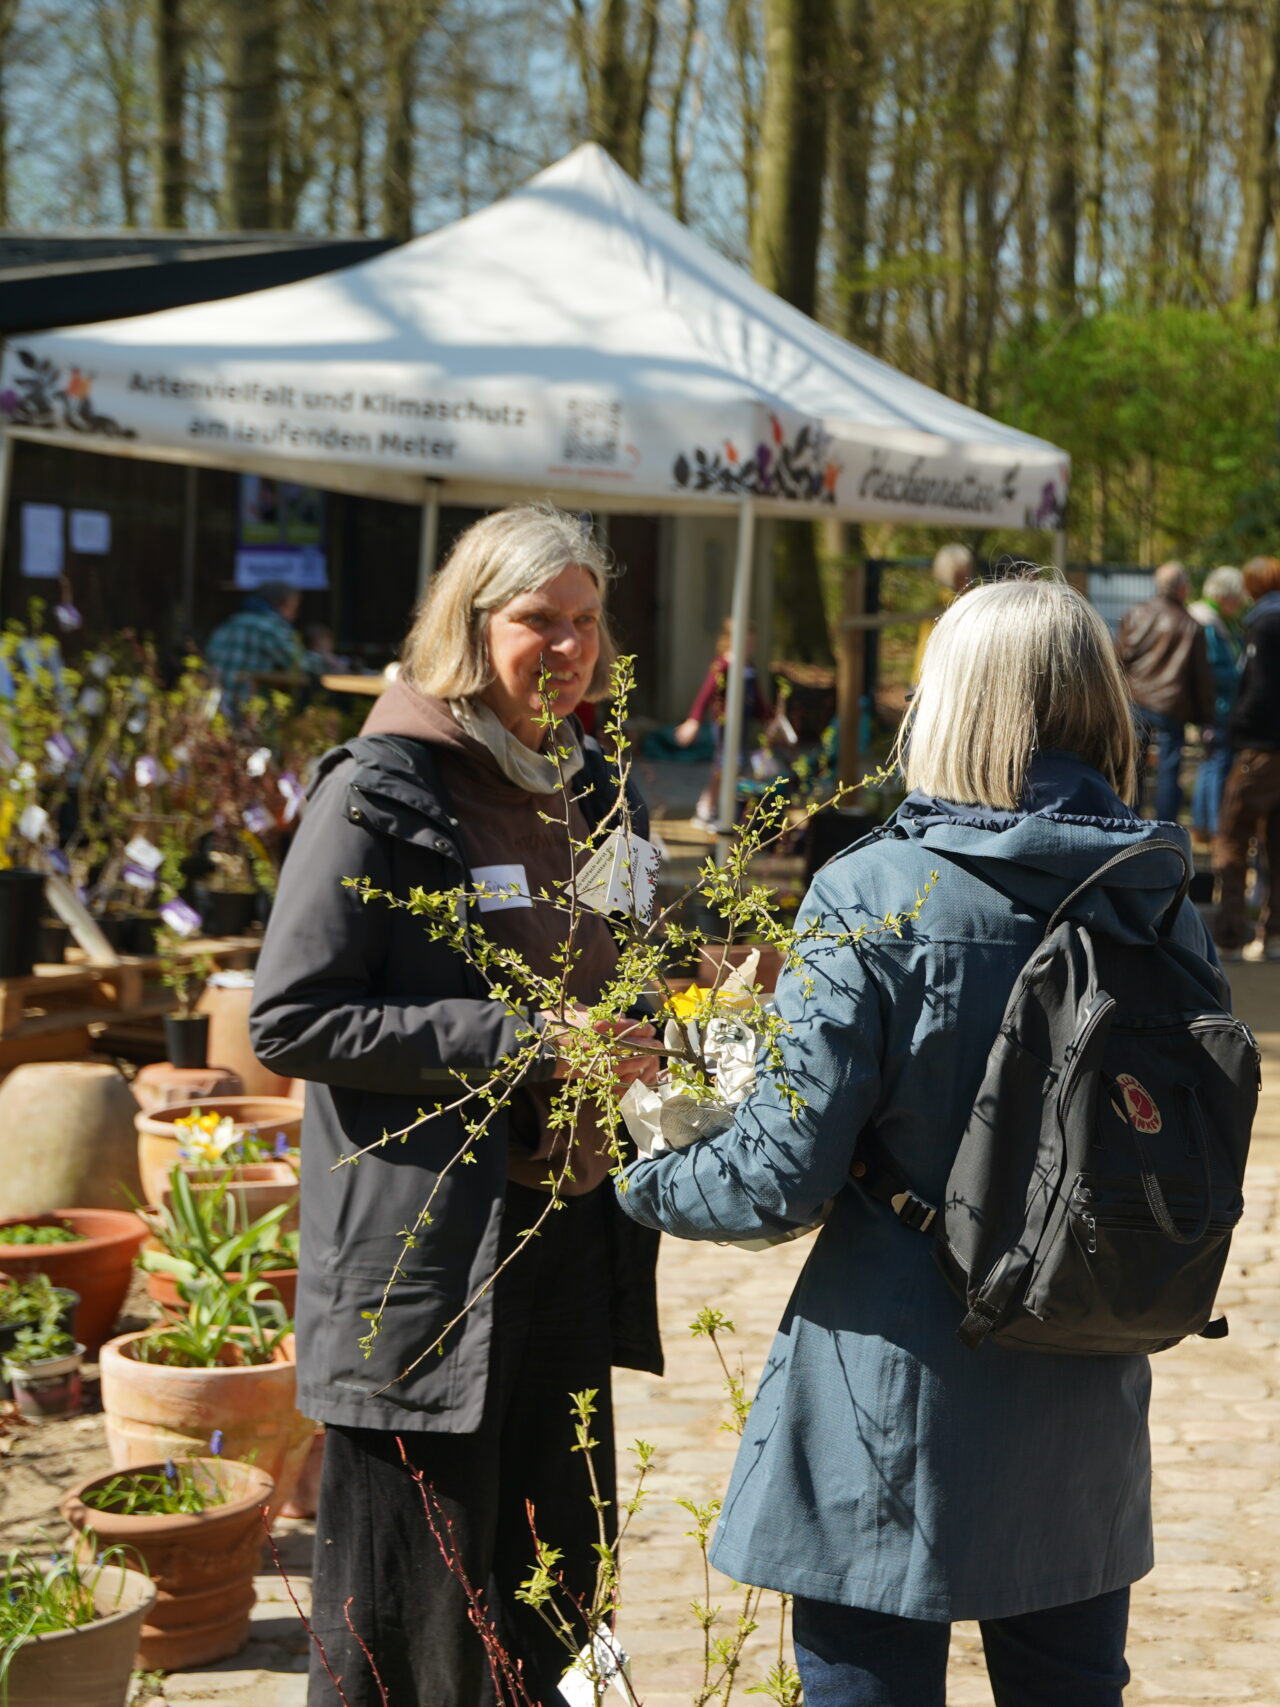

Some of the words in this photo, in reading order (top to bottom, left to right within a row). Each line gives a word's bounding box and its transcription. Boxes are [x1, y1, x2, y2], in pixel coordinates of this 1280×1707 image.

[129, 371, 296, 408] Artenvielfalt
[302, 391, 353, 414] und
[361, 393, 527, 427] Klimaschutz
[188, 418, 229, 438] am
[235, 418, 372, 452] laufenden
[379, 431, 458, 461] Meter
